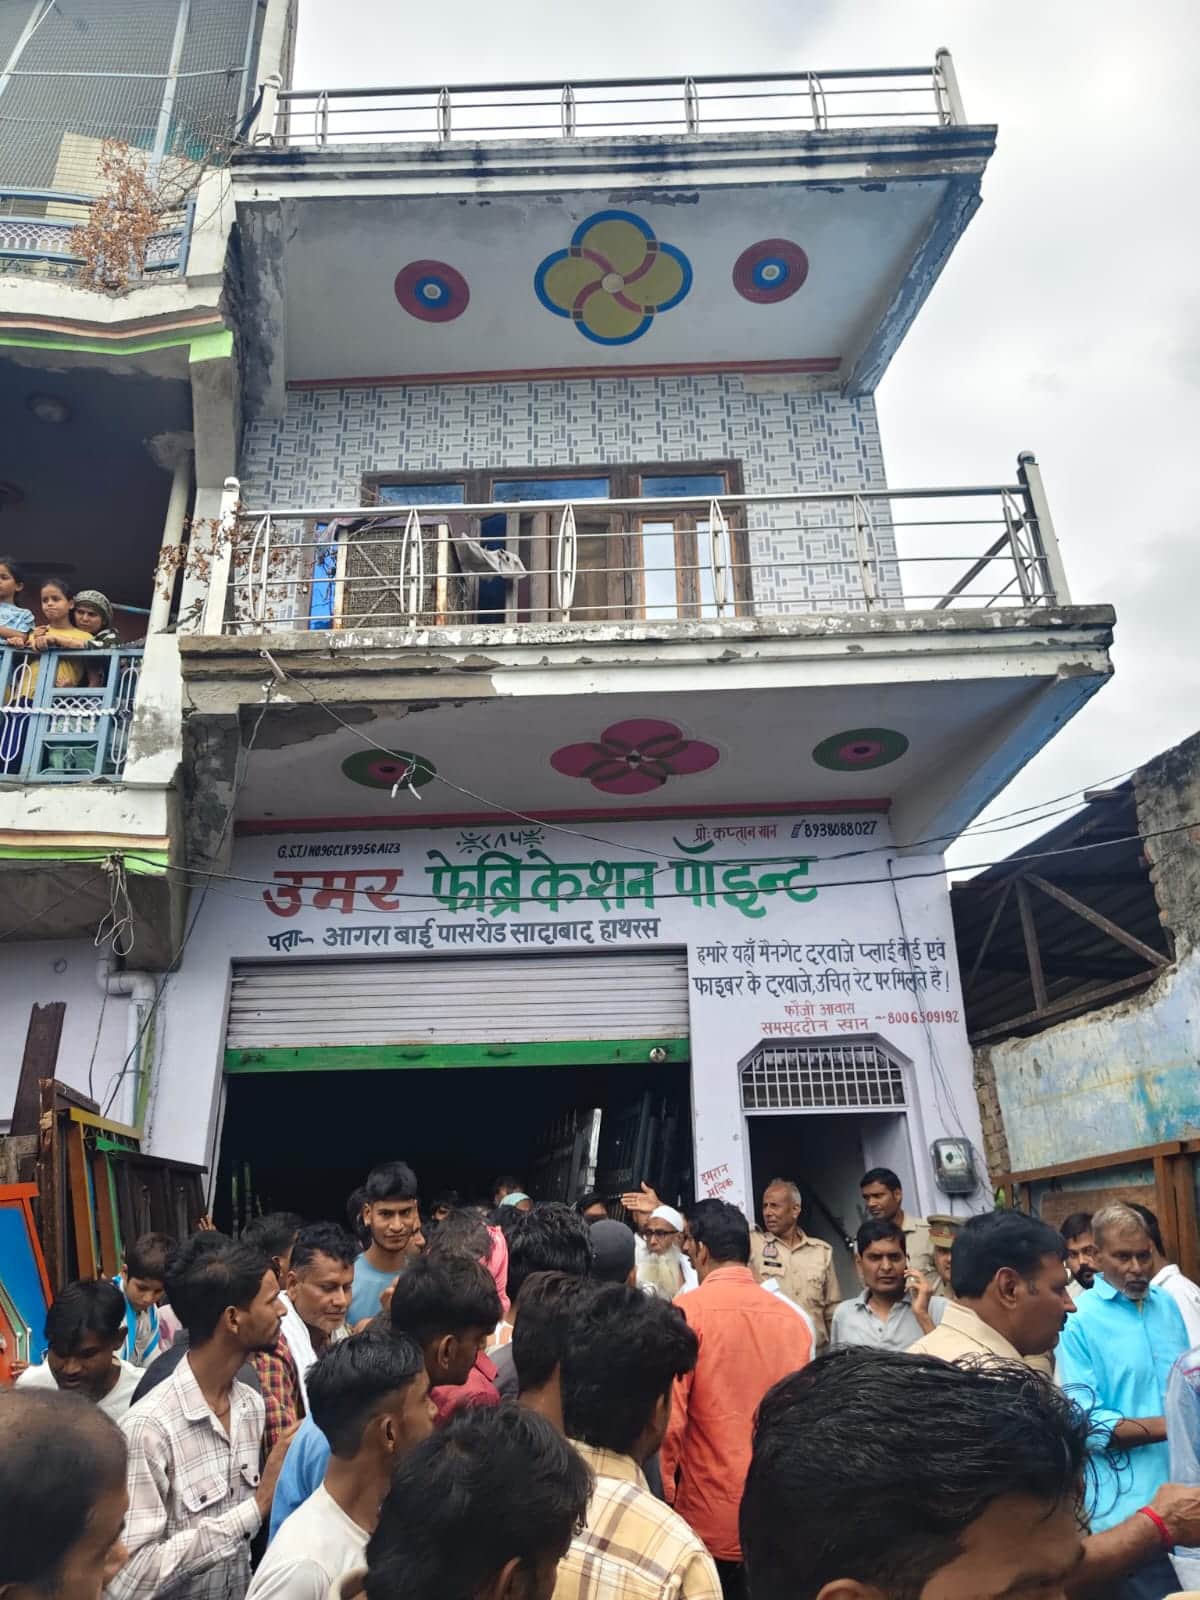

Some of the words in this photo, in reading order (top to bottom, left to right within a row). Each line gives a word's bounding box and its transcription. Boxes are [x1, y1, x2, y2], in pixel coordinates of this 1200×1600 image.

[263, 868, 404, 917] उमर
[323, 926, 392, 947] आगरा
[510, 920, 595, 945] सादाबाद
[598, 918, 660, 943] हाथरस
[696, 941, 729, 966] हमारे
[805, 939, 855, 966] दरवाजे
[924, 937, 946, 961] एवं
[692, 976, 744, 998] फाइबर
[746, 971, 762, 995] के
[816, 968, 850, 995] उचित
[851, 968, 872, 991] रेट
[819, 1002, 856, 1016] आवास
